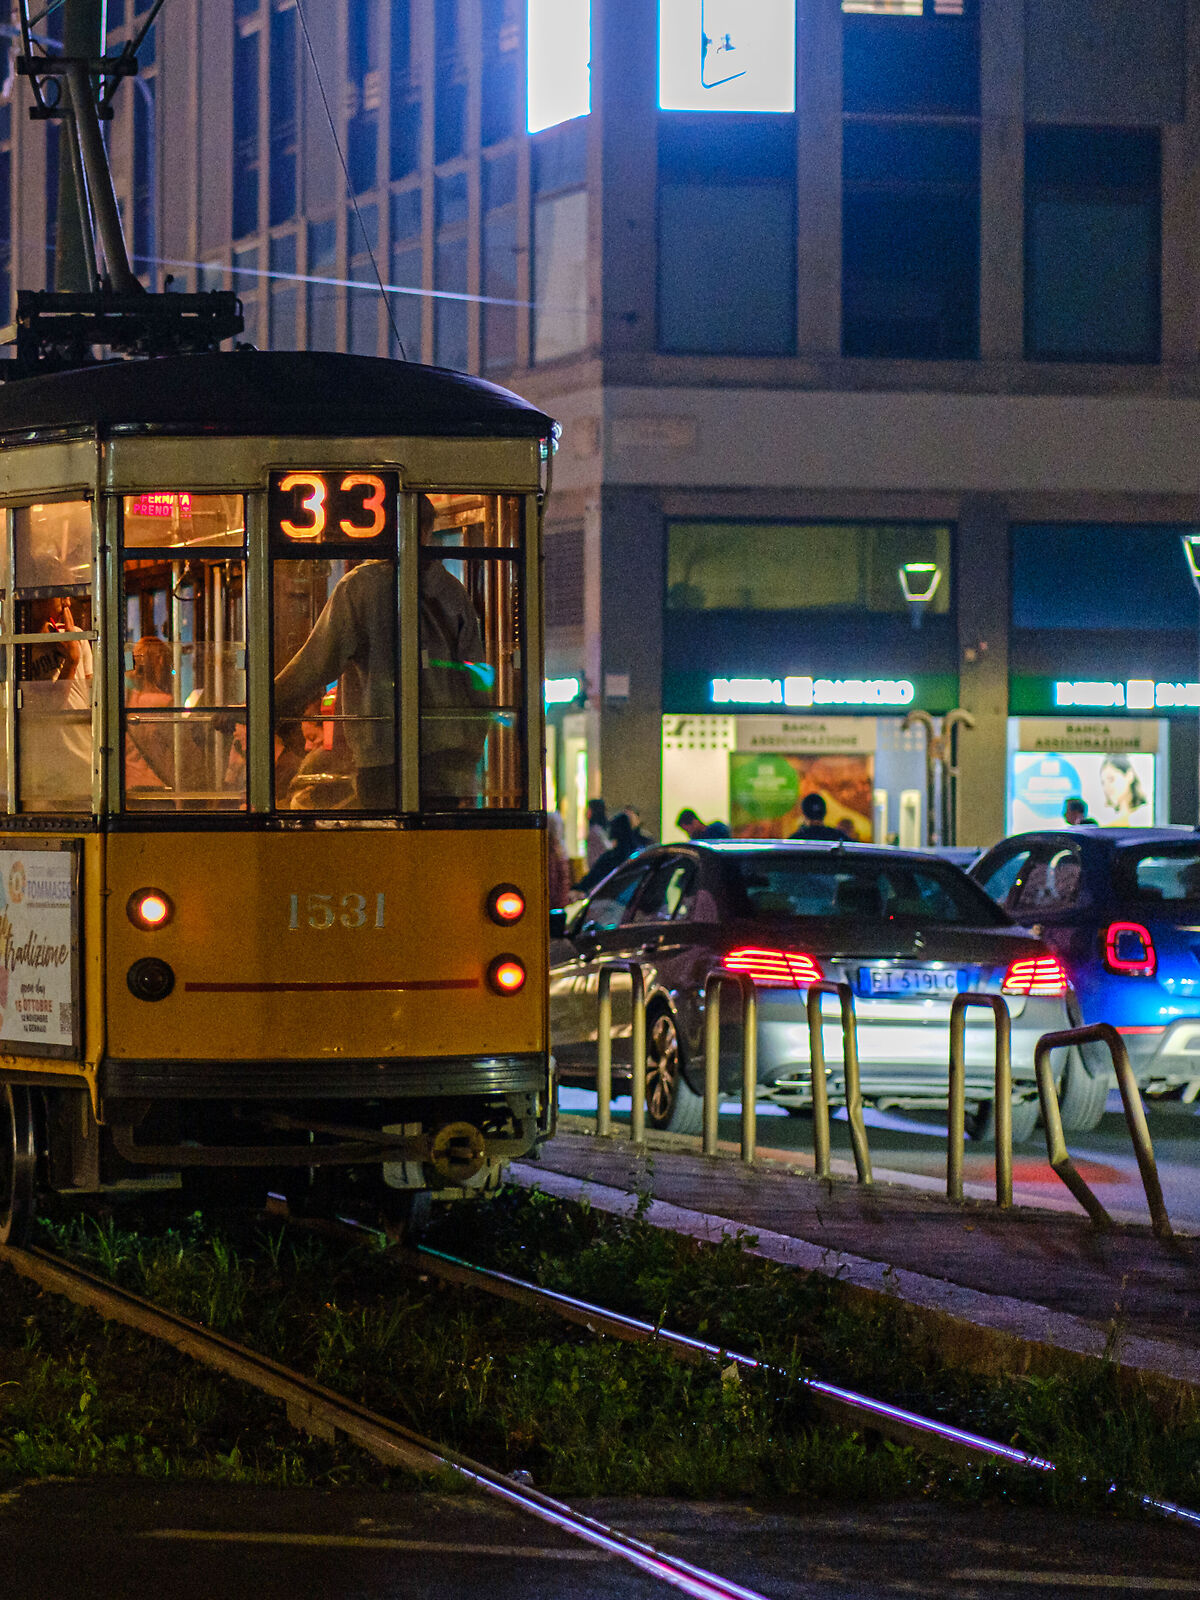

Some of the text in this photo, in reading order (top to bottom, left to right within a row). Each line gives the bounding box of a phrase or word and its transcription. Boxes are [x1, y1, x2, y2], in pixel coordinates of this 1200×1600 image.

[279, 474, 386, 538] 33
[288, 893, 385, 929] 1531
[23, 999, 53, 1013] OTTOBRE
